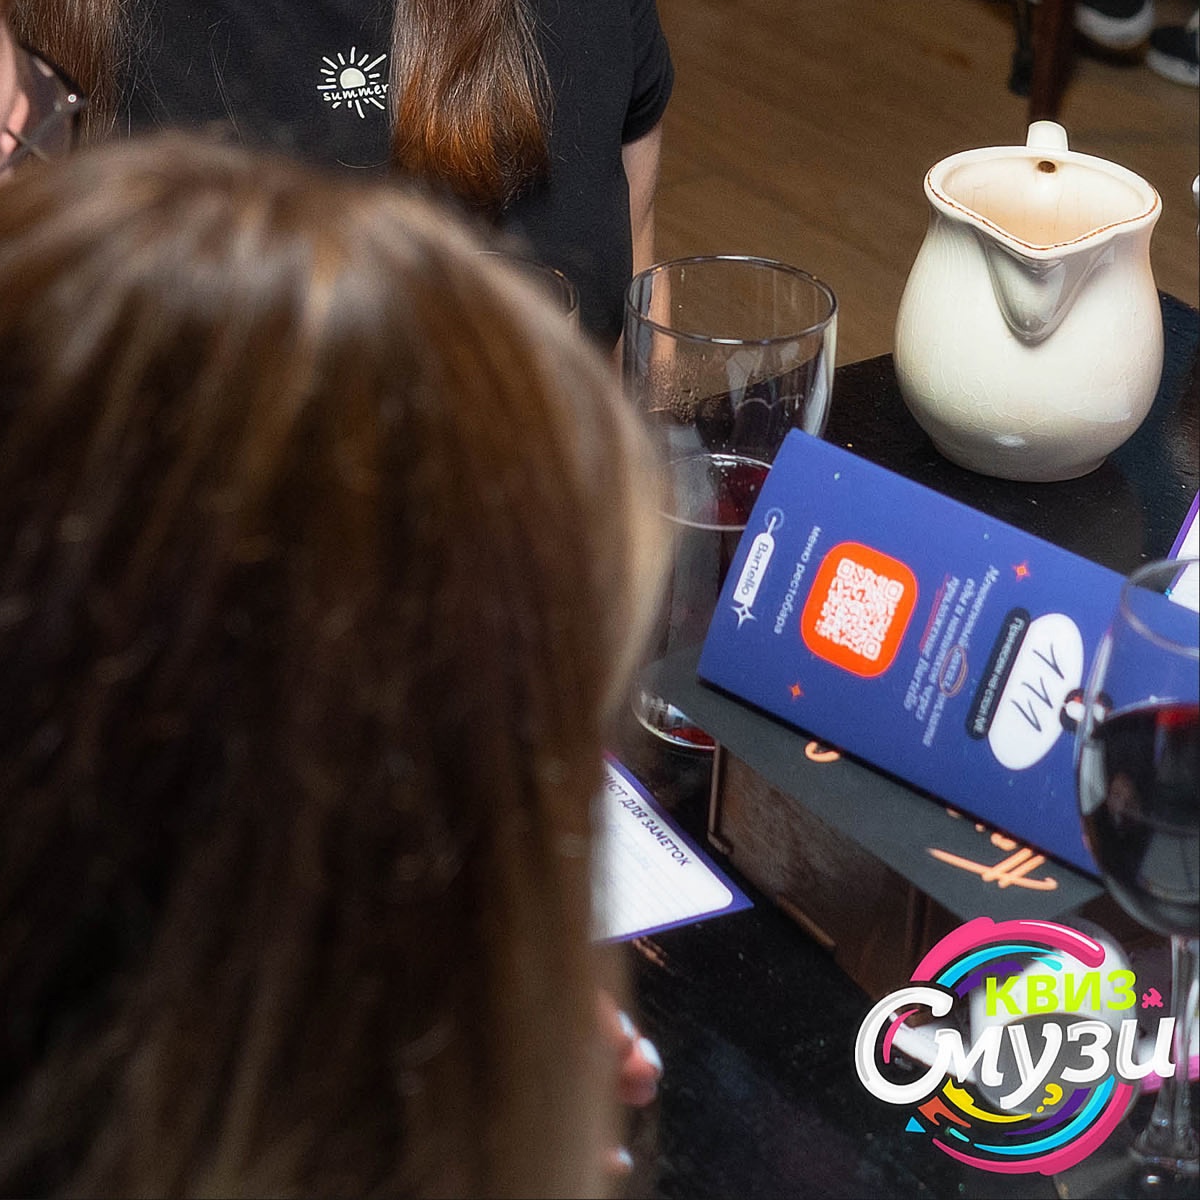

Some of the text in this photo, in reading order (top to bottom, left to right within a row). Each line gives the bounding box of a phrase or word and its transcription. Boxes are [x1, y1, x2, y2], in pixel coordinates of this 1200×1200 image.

[323, 84, 389, 101] summer
[739, 541, 770, 597] Bartello
[772, 524, 822, 635] меню рестобара
[1010, 642, 1065, 734] 111
[620, 798, 648, 819] ДЛЯ
[641, 818, 692, 867] ЗАМЕТОК
